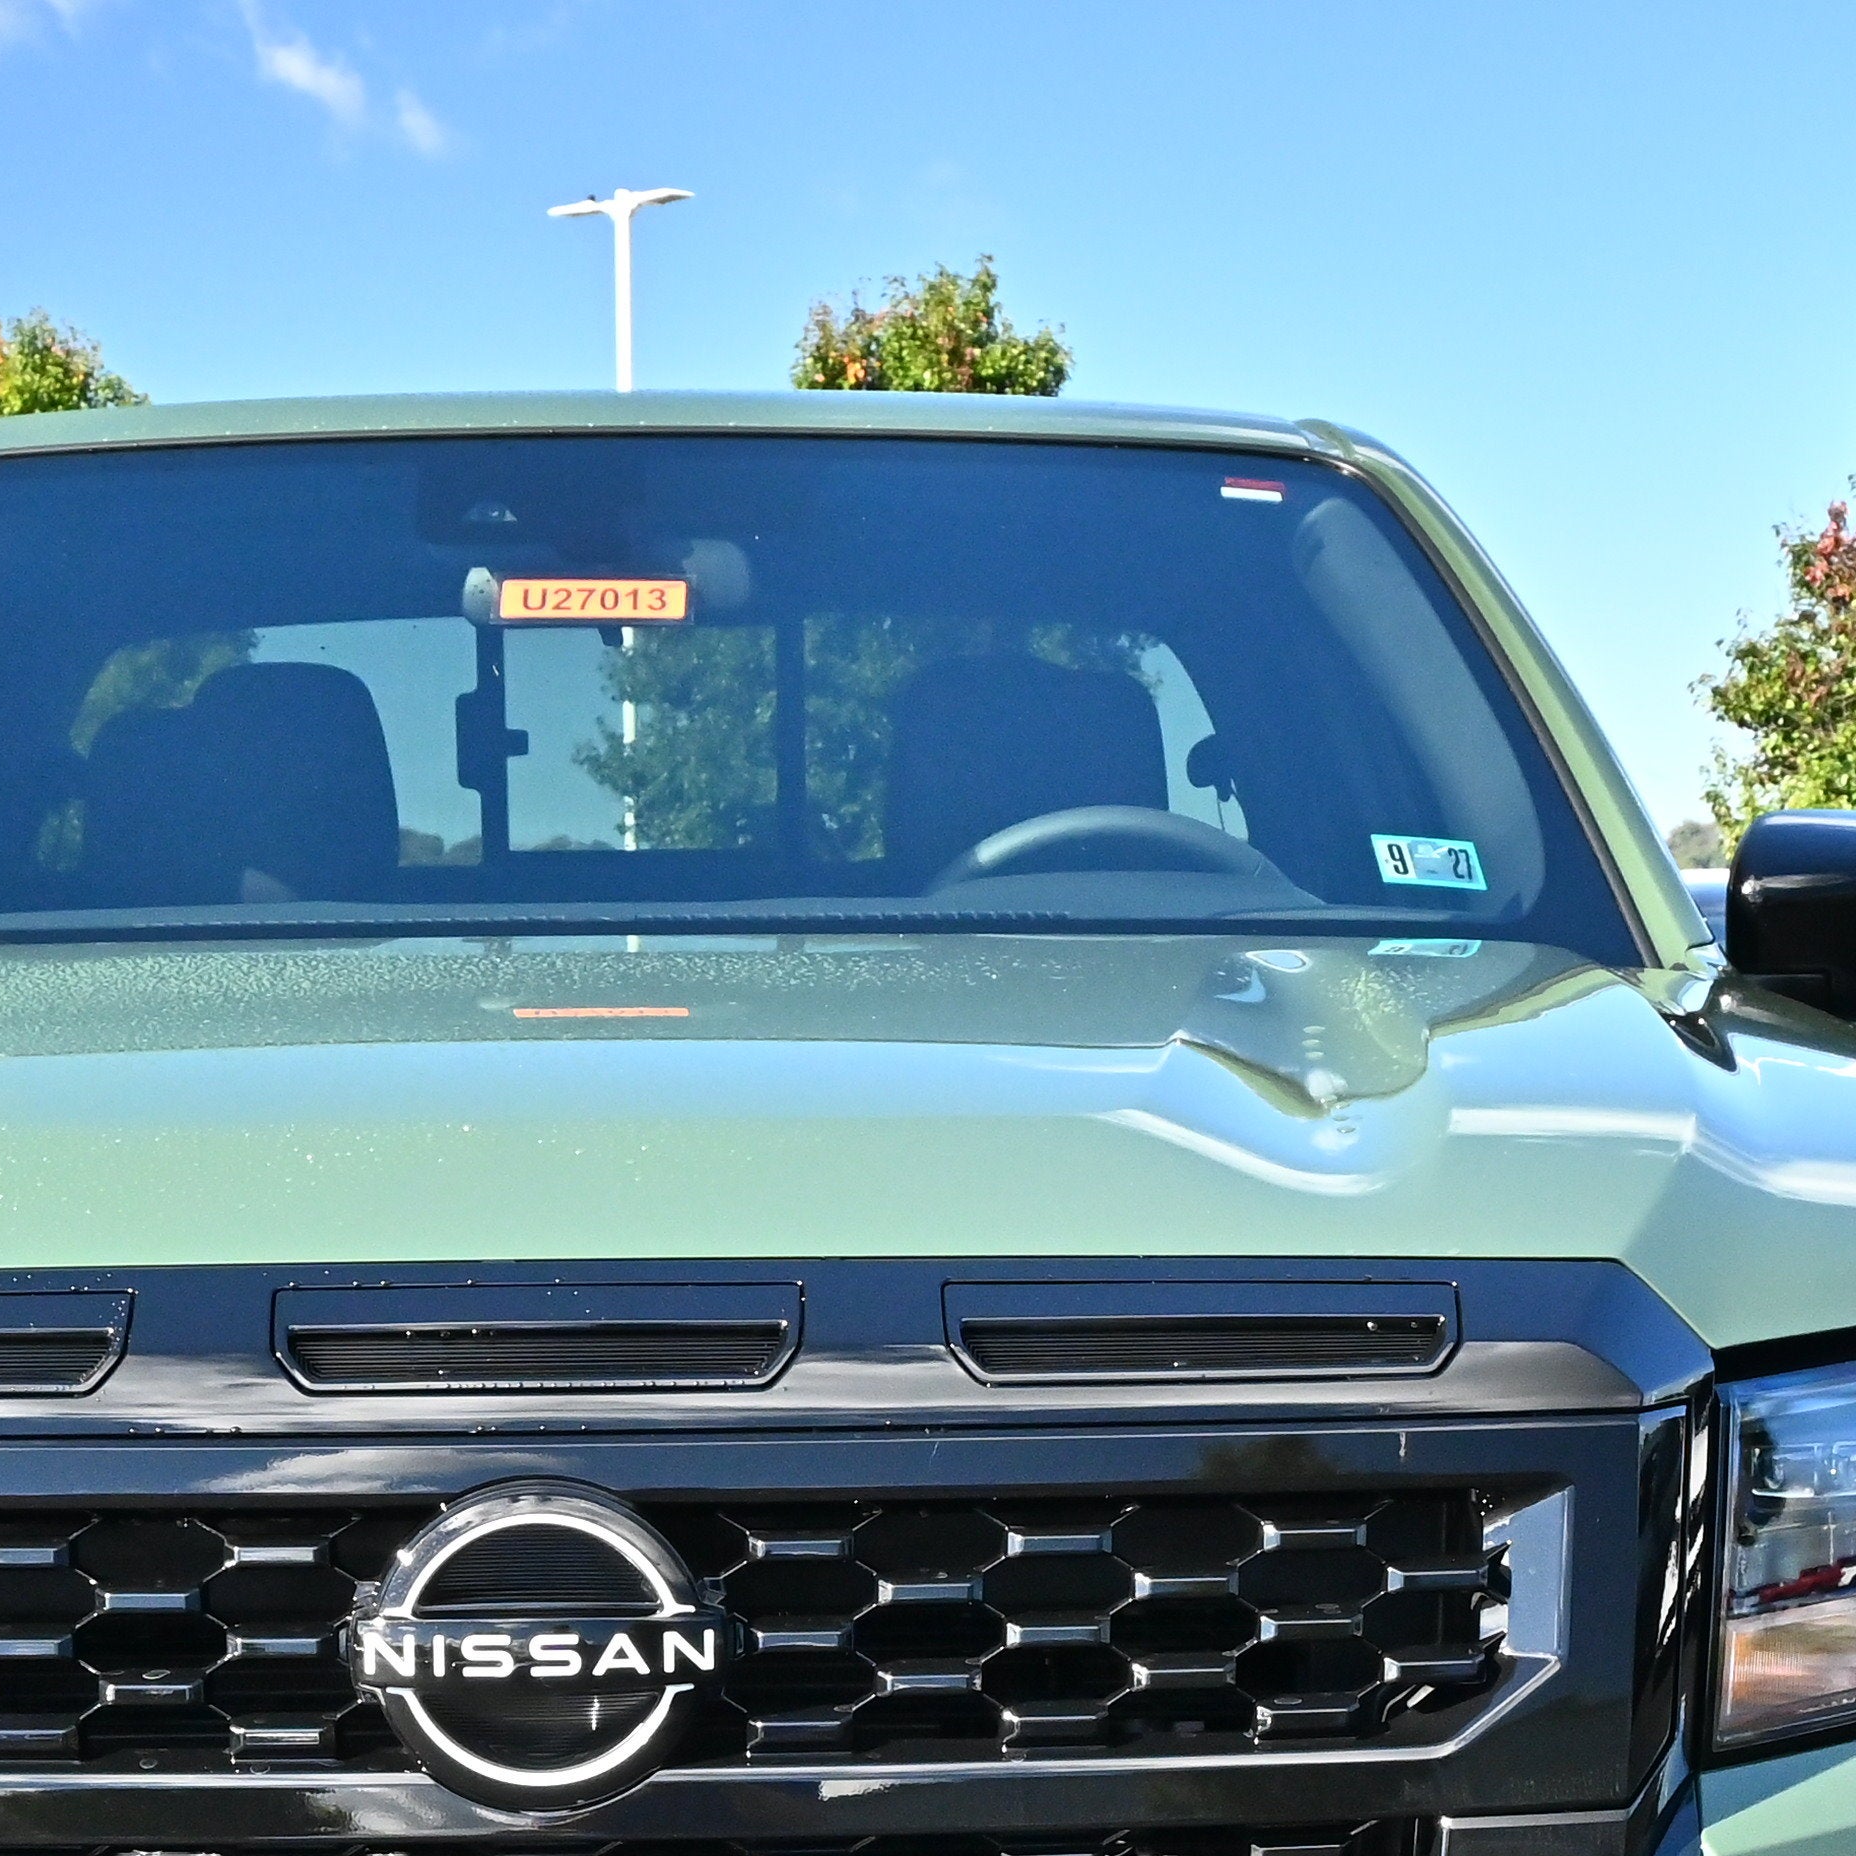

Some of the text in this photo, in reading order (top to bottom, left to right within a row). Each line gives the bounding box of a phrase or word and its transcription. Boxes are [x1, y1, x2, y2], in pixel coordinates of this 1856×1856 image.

[522, 588, 666, 611] U27013
[1386, 843, 1472, 880] 9 27
[362, 1629, 715, 1678] NISSAN
